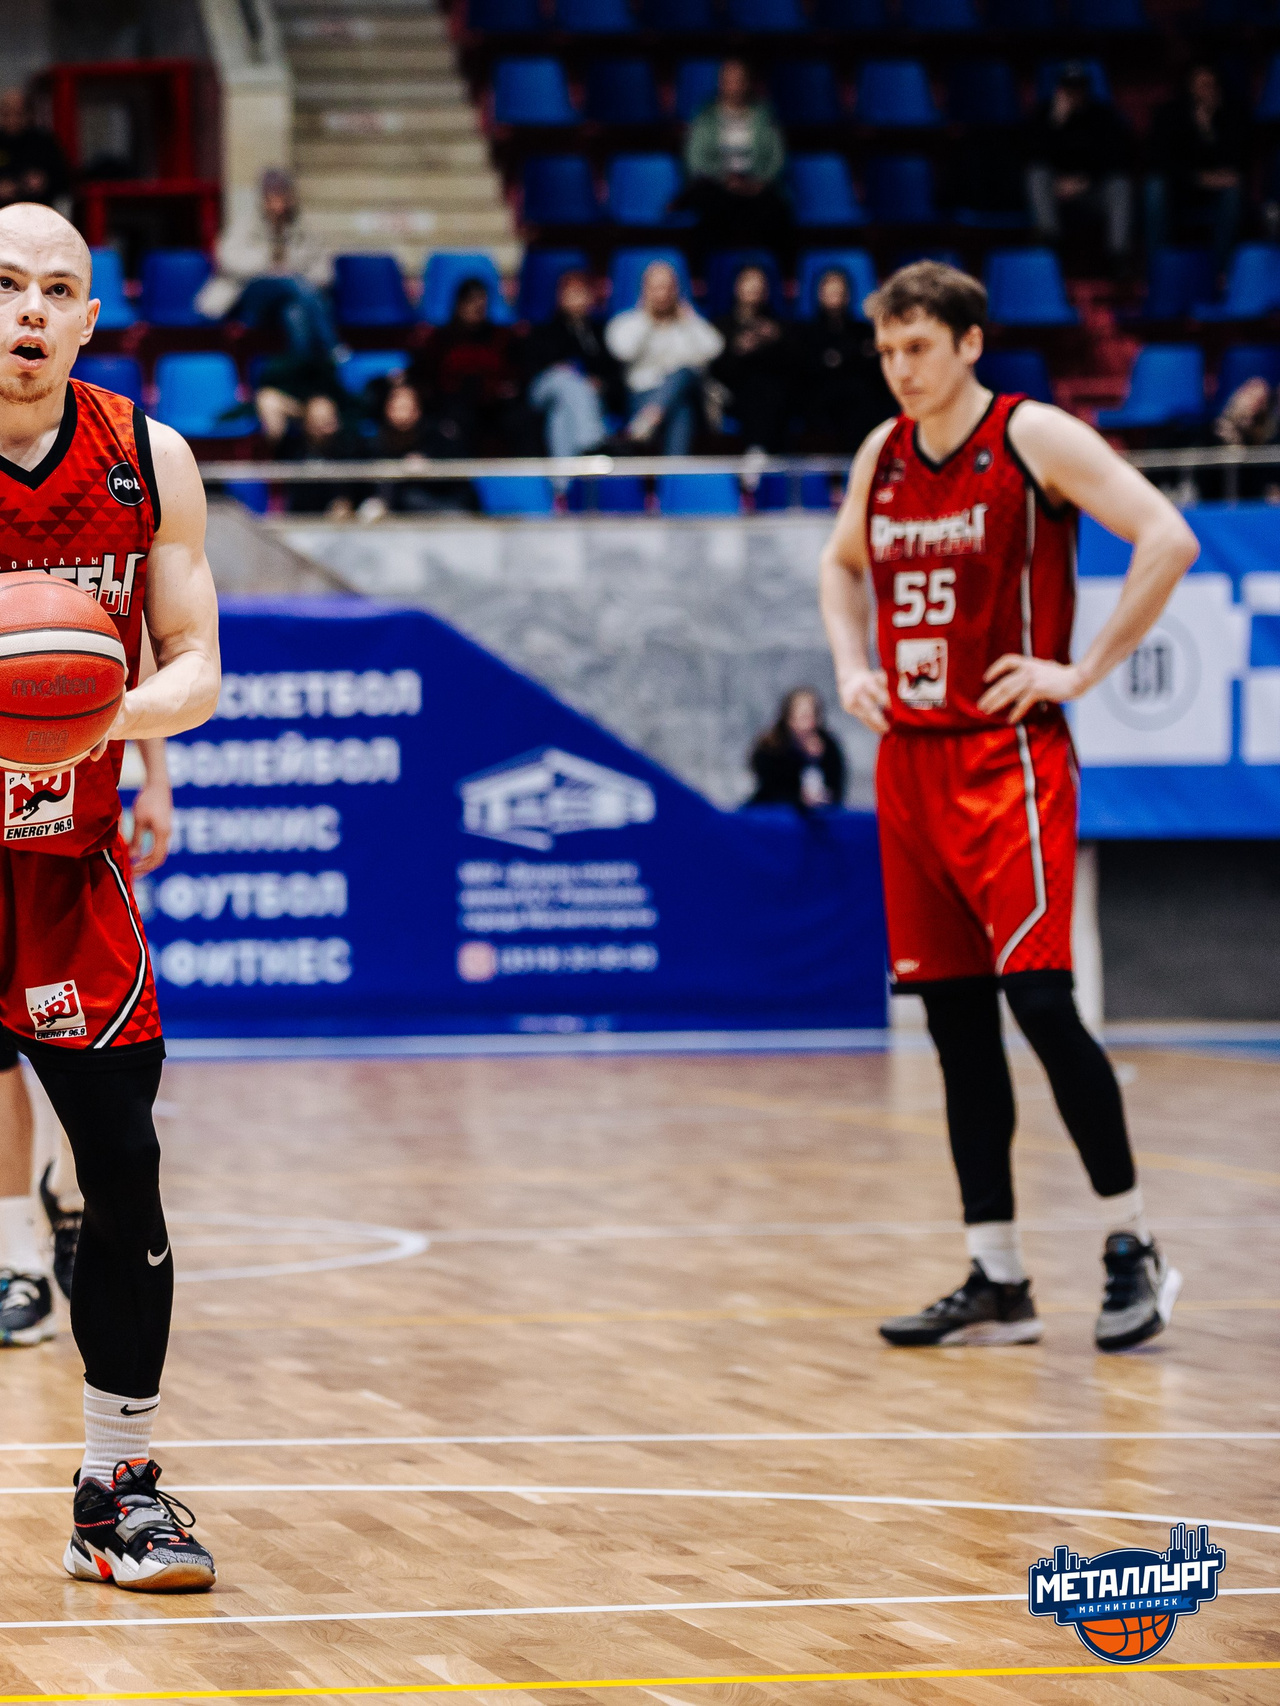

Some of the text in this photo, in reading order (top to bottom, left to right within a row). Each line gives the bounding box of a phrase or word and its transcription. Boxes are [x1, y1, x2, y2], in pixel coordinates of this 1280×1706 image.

[892, 568, 956, 628] 55
[12, 675, 96, 697] molten
[6, 818, 72, 839] ENERGY 96.9
[157, 871, 347, 921] ФУТБОЛ
[160, 937, 352, 986] ФИТНЕС
[32, 983, 79, 1027] NRJ
[36, 1027, 86, 1039] ENERGY 96.9
